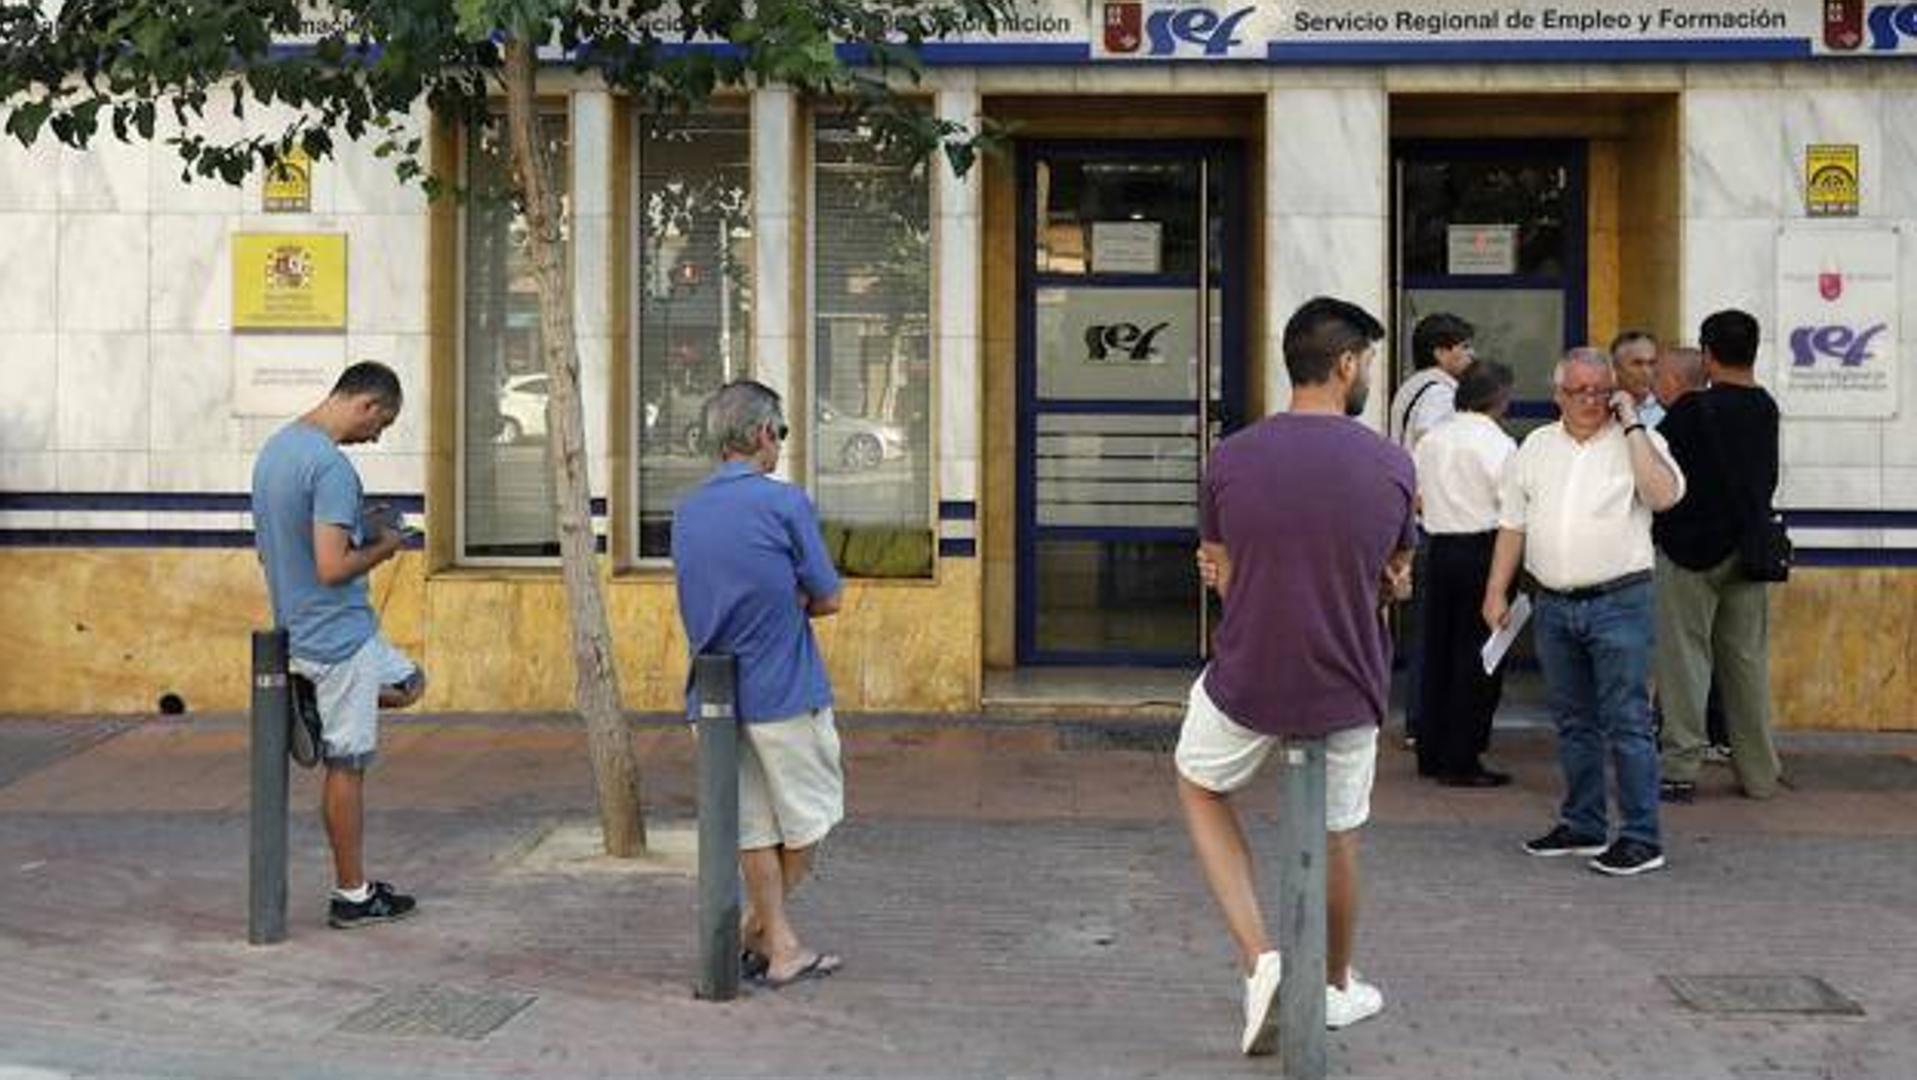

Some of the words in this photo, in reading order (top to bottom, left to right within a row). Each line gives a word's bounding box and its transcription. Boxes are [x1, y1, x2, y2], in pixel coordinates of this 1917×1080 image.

[1294, 11, 1389, 32] Servicio
[1396, 9, 1499, 34] Regional
[1506, 9, 1535, 29] de
[1543, 8, 1631, 32] Empleo
[1638, 14, 1652, 32] y
[1659, 8, 1787, 29] Formación
